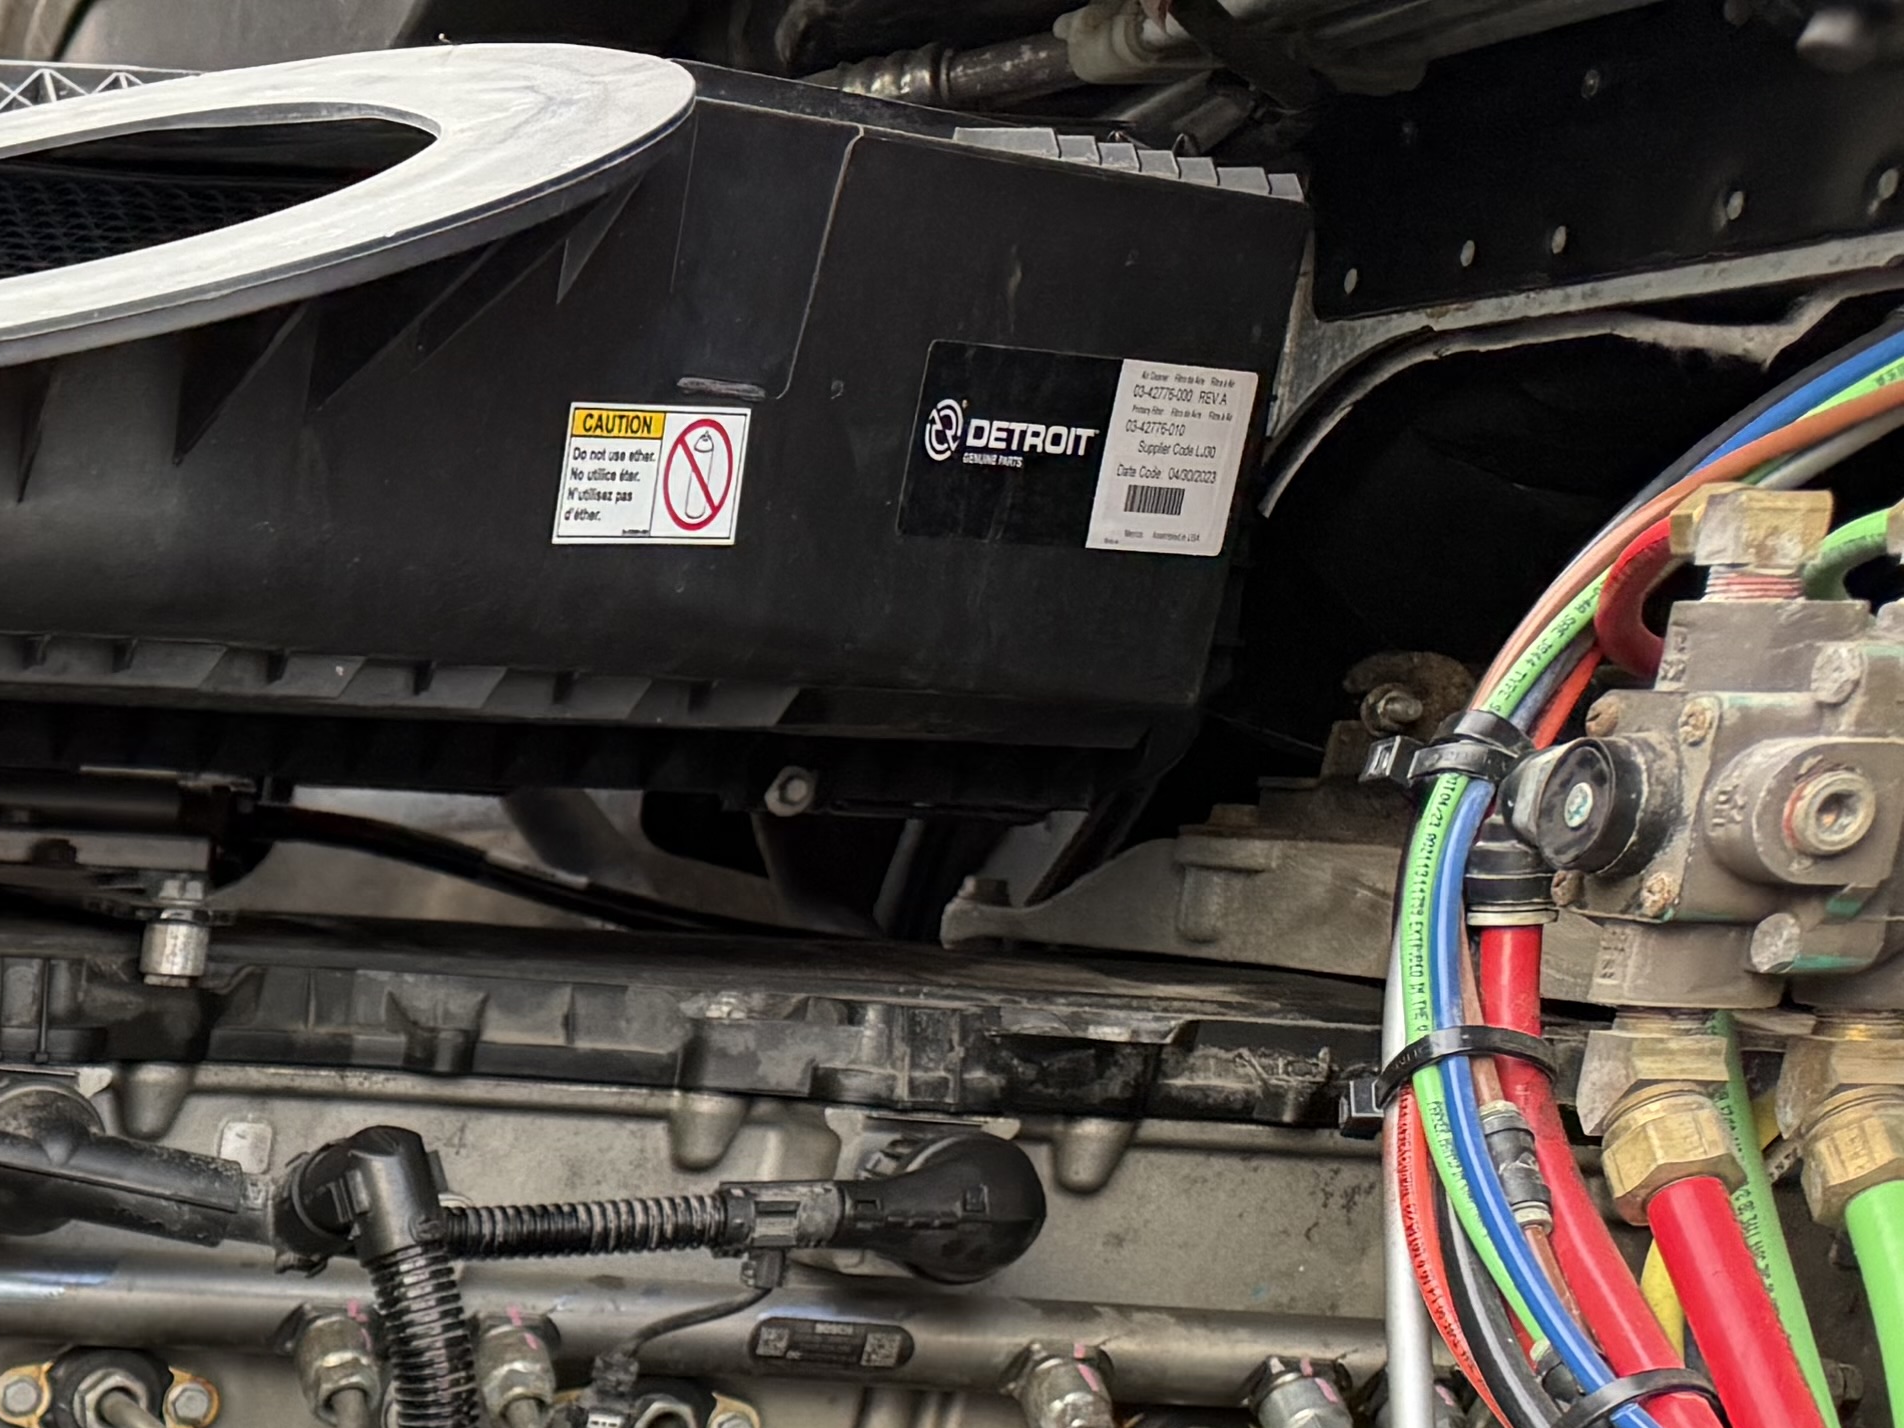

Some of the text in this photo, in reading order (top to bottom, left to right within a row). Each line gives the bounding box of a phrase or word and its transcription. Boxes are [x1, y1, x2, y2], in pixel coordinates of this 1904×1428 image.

[1133, 384, 1193, 403] 03-42776-000
[583, 414, 652, 434] CAUTION
[1125, 420, 1186, 436] 03-42776-010
[966, 419, 1095, 456] DETROIT
[573, 448, 655, 462] Do not use ether.
[1138, 441, 1194, 456] Supplier Code
[963, 452, 1024, 468] GENUINE PARTS
[570, 468, 640, 482] No utilice éter.
[1117, 464, 1137, 478] Date
[1168, 467, 1217, 484] 04/30/2023
[567, 488, 632, 504] N'utilisez pas
